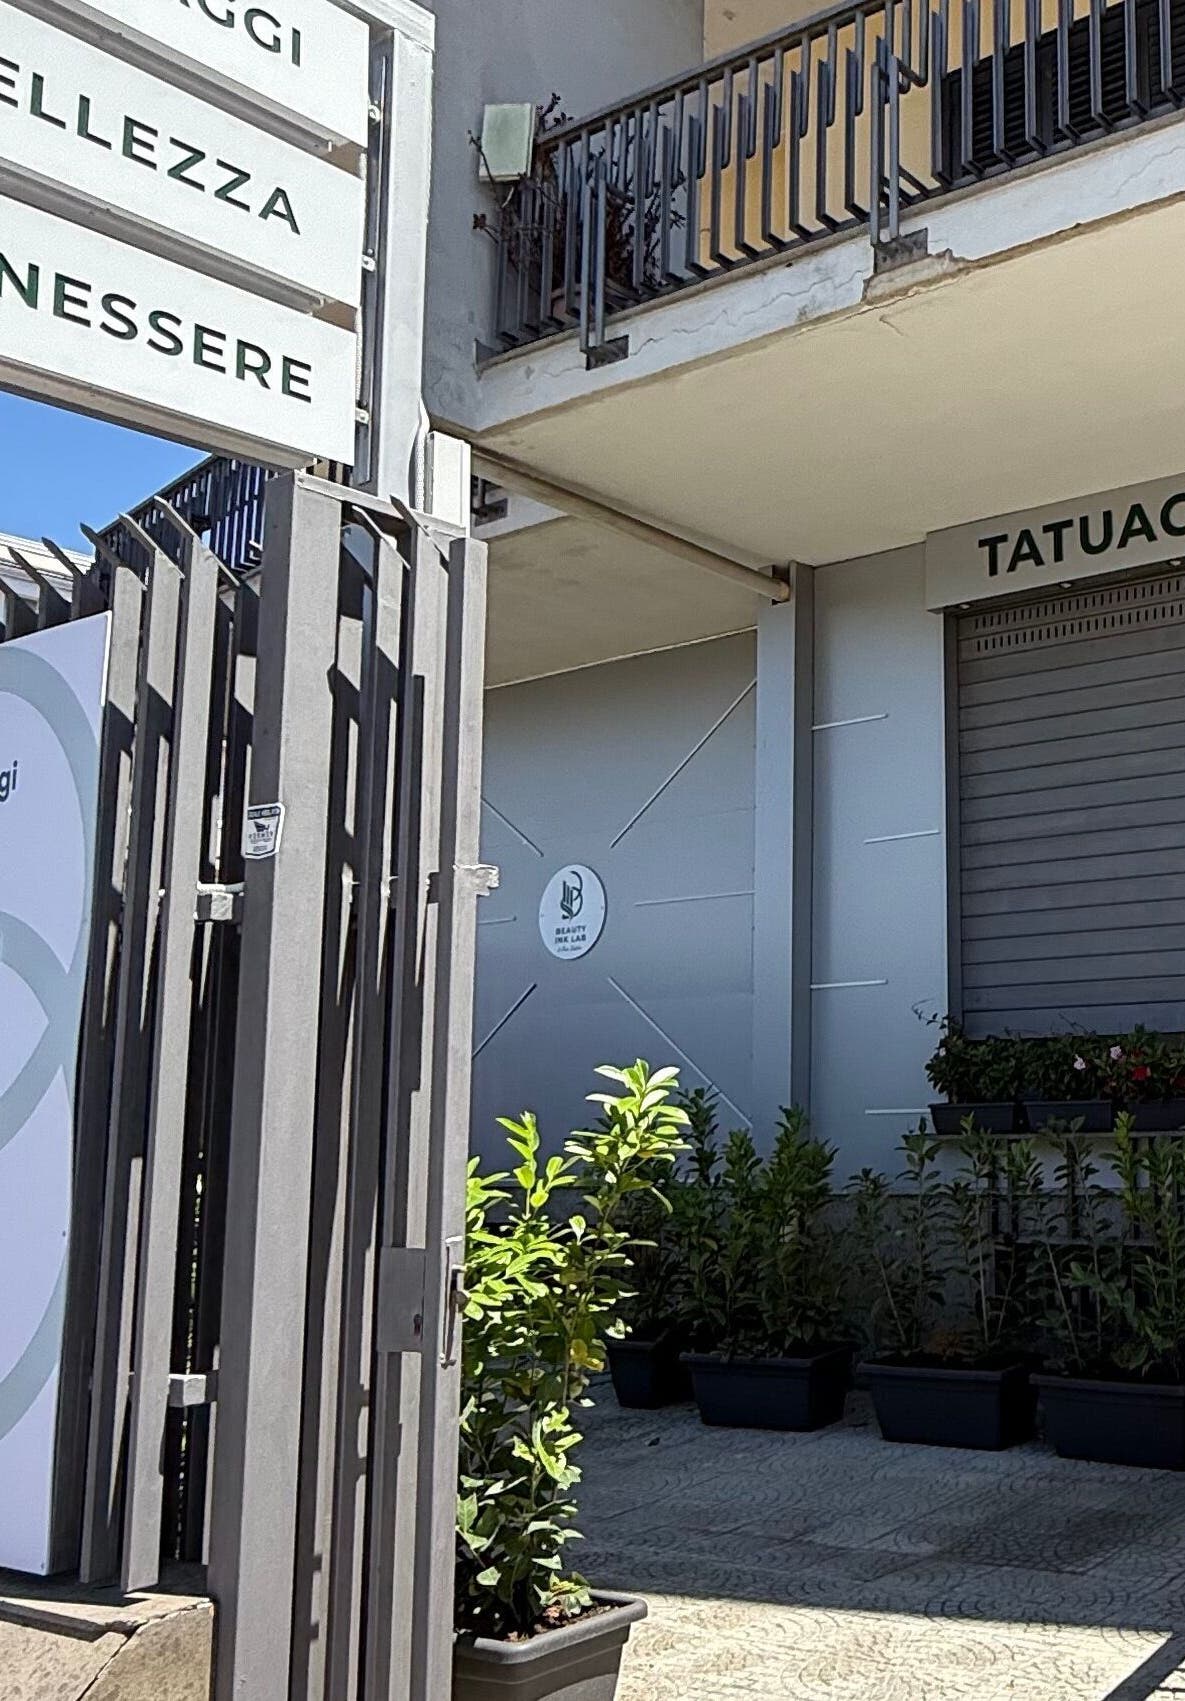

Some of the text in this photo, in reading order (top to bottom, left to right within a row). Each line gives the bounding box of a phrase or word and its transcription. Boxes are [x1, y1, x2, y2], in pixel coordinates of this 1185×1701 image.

[180, 0, 301, 66] GGI
[0, 252, 312, 403] NESSERE
[554, 934, 587, 944] INK LAB
[555, 925, 587, 936] BEAUTY
